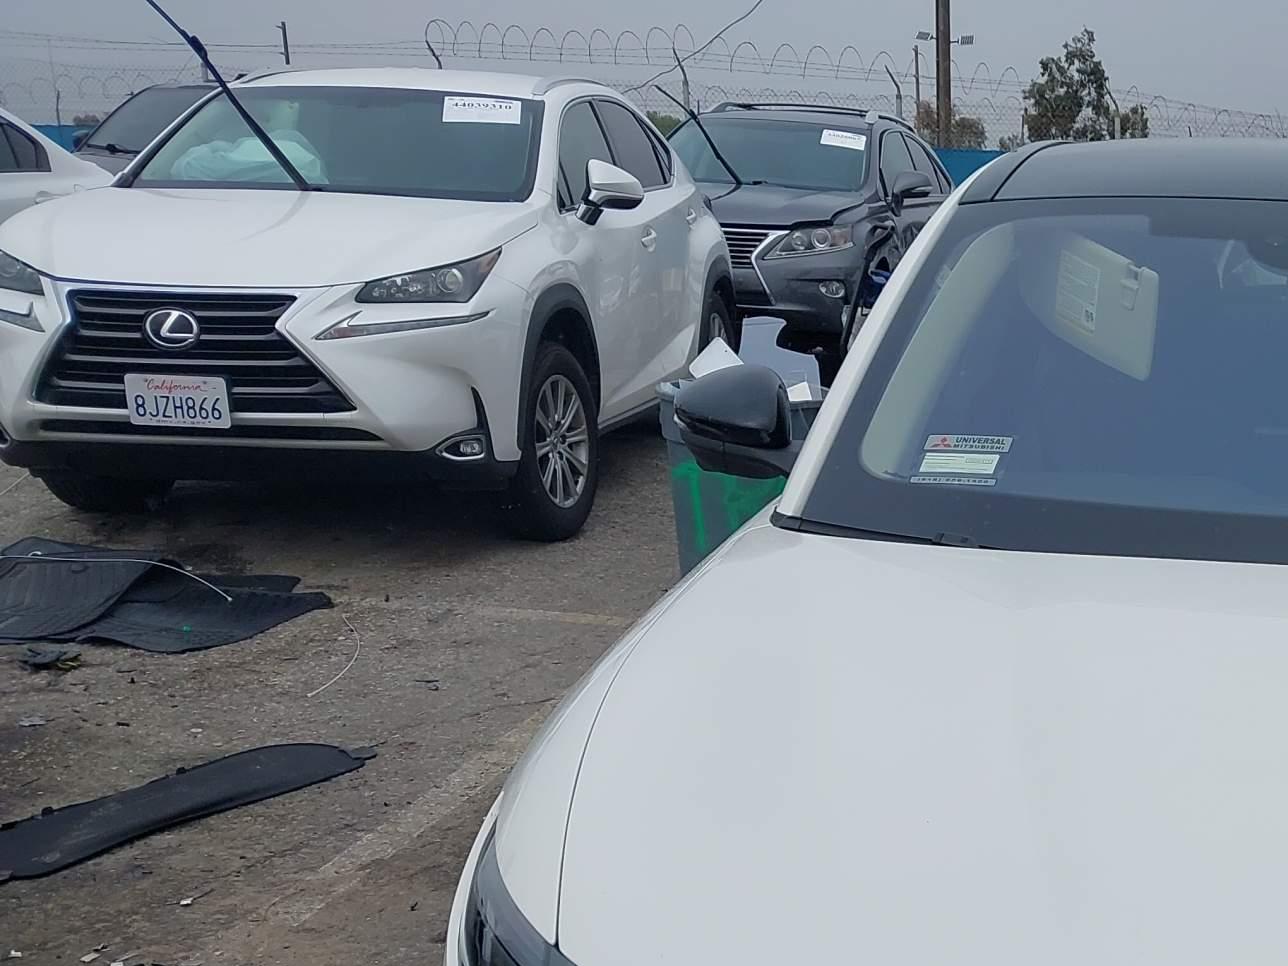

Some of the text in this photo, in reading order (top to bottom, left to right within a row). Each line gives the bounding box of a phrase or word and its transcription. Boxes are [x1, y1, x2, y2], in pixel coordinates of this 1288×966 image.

[146, 378, 207, 395] California
[134, 394, 222, 420] 8JZH866
[955, 437, 1005, 445] UNIVERSAL
